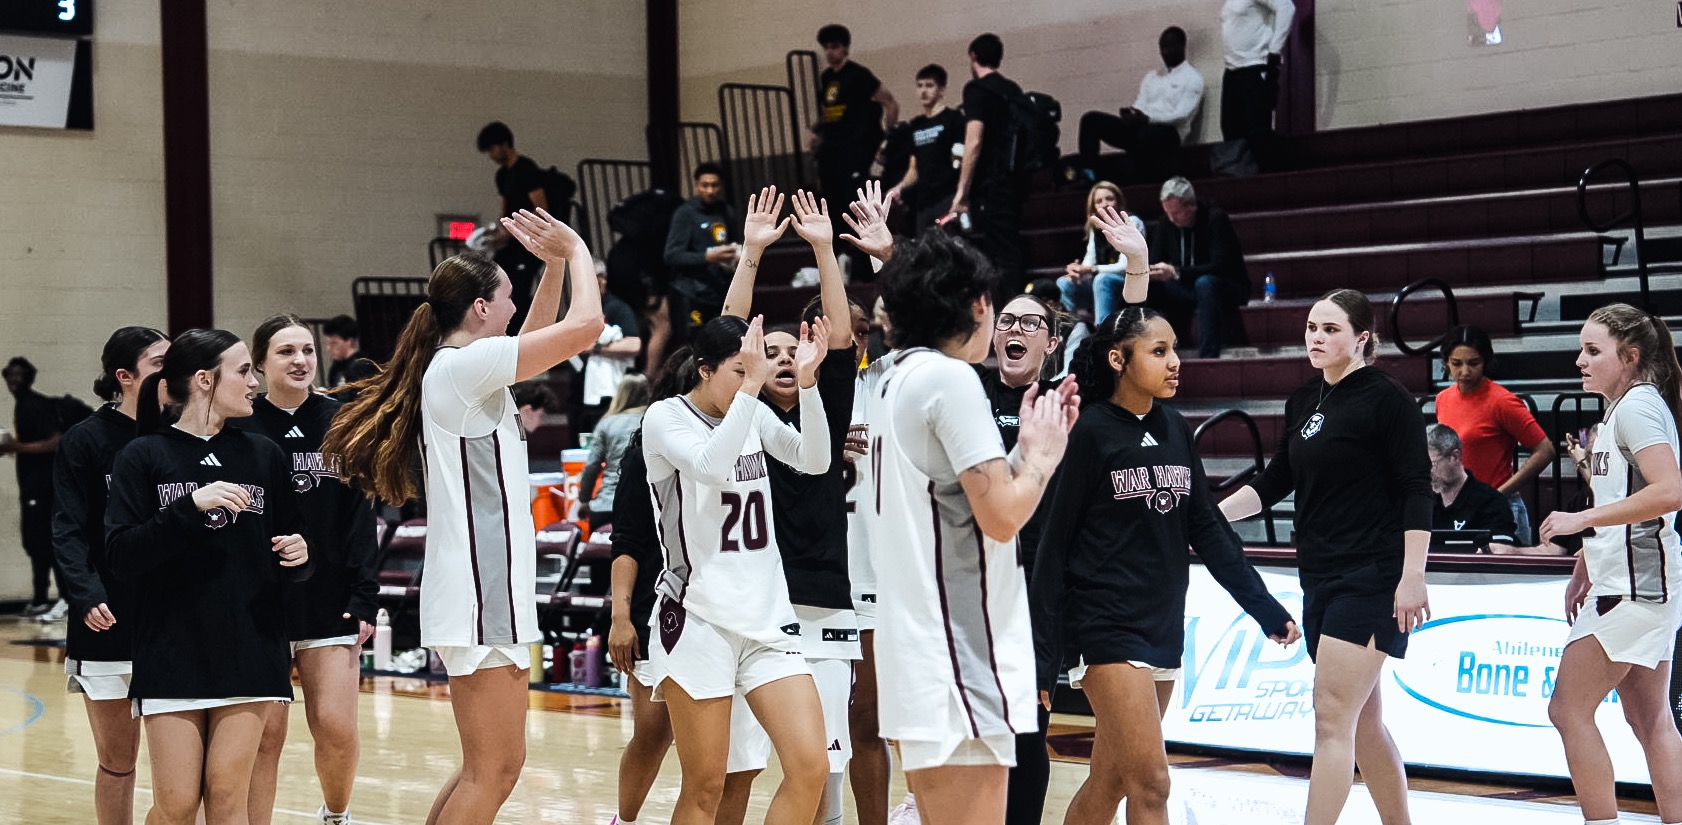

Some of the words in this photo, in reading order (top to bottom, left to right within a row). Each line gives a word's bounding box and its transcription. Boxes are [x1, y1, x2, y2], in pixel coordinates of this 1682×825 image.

[292, 452, 342, 473] HAW
[1110, 466, 1152, 494] WAR
[719, 489, 770, 554] 20
[1182, 592, 1308, 710] VIP
[1456, 650, 1530, 698] Bone
